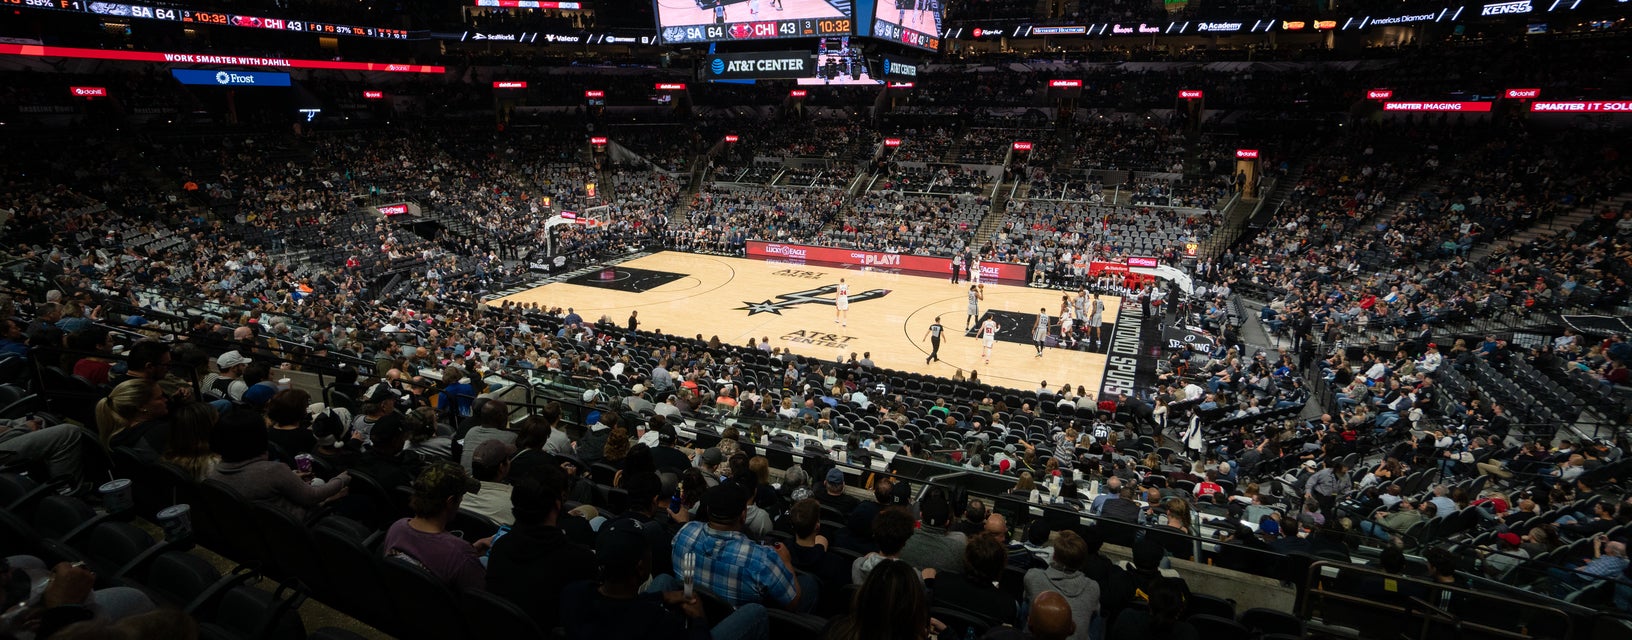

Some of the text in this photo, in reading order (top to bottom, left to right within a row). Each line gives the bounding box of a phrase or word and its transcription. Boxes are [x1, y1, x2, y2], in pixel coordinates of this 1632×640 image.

[61, 0, 69, 8] F
[72, 2, 80, 10] 1
[132, 6, 152, 18] SA
[155, 8, 175, 20] 64
[194, 12, 227, 24] 10:32
[1370, 12, 1435, 25] Americus Diamond
[264, 19, 302, 31] CHI 43
[310, 23, 316, 31] F
[336, 26, 352, 34] 37%
[353, 27, 365, 35] TOL
[755, 22, 796, 35] CHI 43
[805, 20, 811, 29] 3
[819, 19, 850, 33] 10:32
[686, 26, 723, 39] SA 64
[884, 25, 900, 39] SA 64
[918, 35, 924, 46] 43
[164, 53, 291, 67] WORK SMARTER WITH DAHILL
[727, 58, 804, 72] AT&T CENTER
[901, 63, 917, 76] CENTER
[230, 73, 255, 83] Frost
[765, 245, 783, 254] LUCKY
[529, 261, 550, 271] SPALDING
[865, 254, 901, 265] PLAY!
[771, 271, 821, 280] CENTER
[786, 329, 859, 343] AT&T
[1112, 315, 1141, 355] ANTONIO
[779, 335, 849, 349] CENTER
[1103, 355, 1137, 396] SPURS
